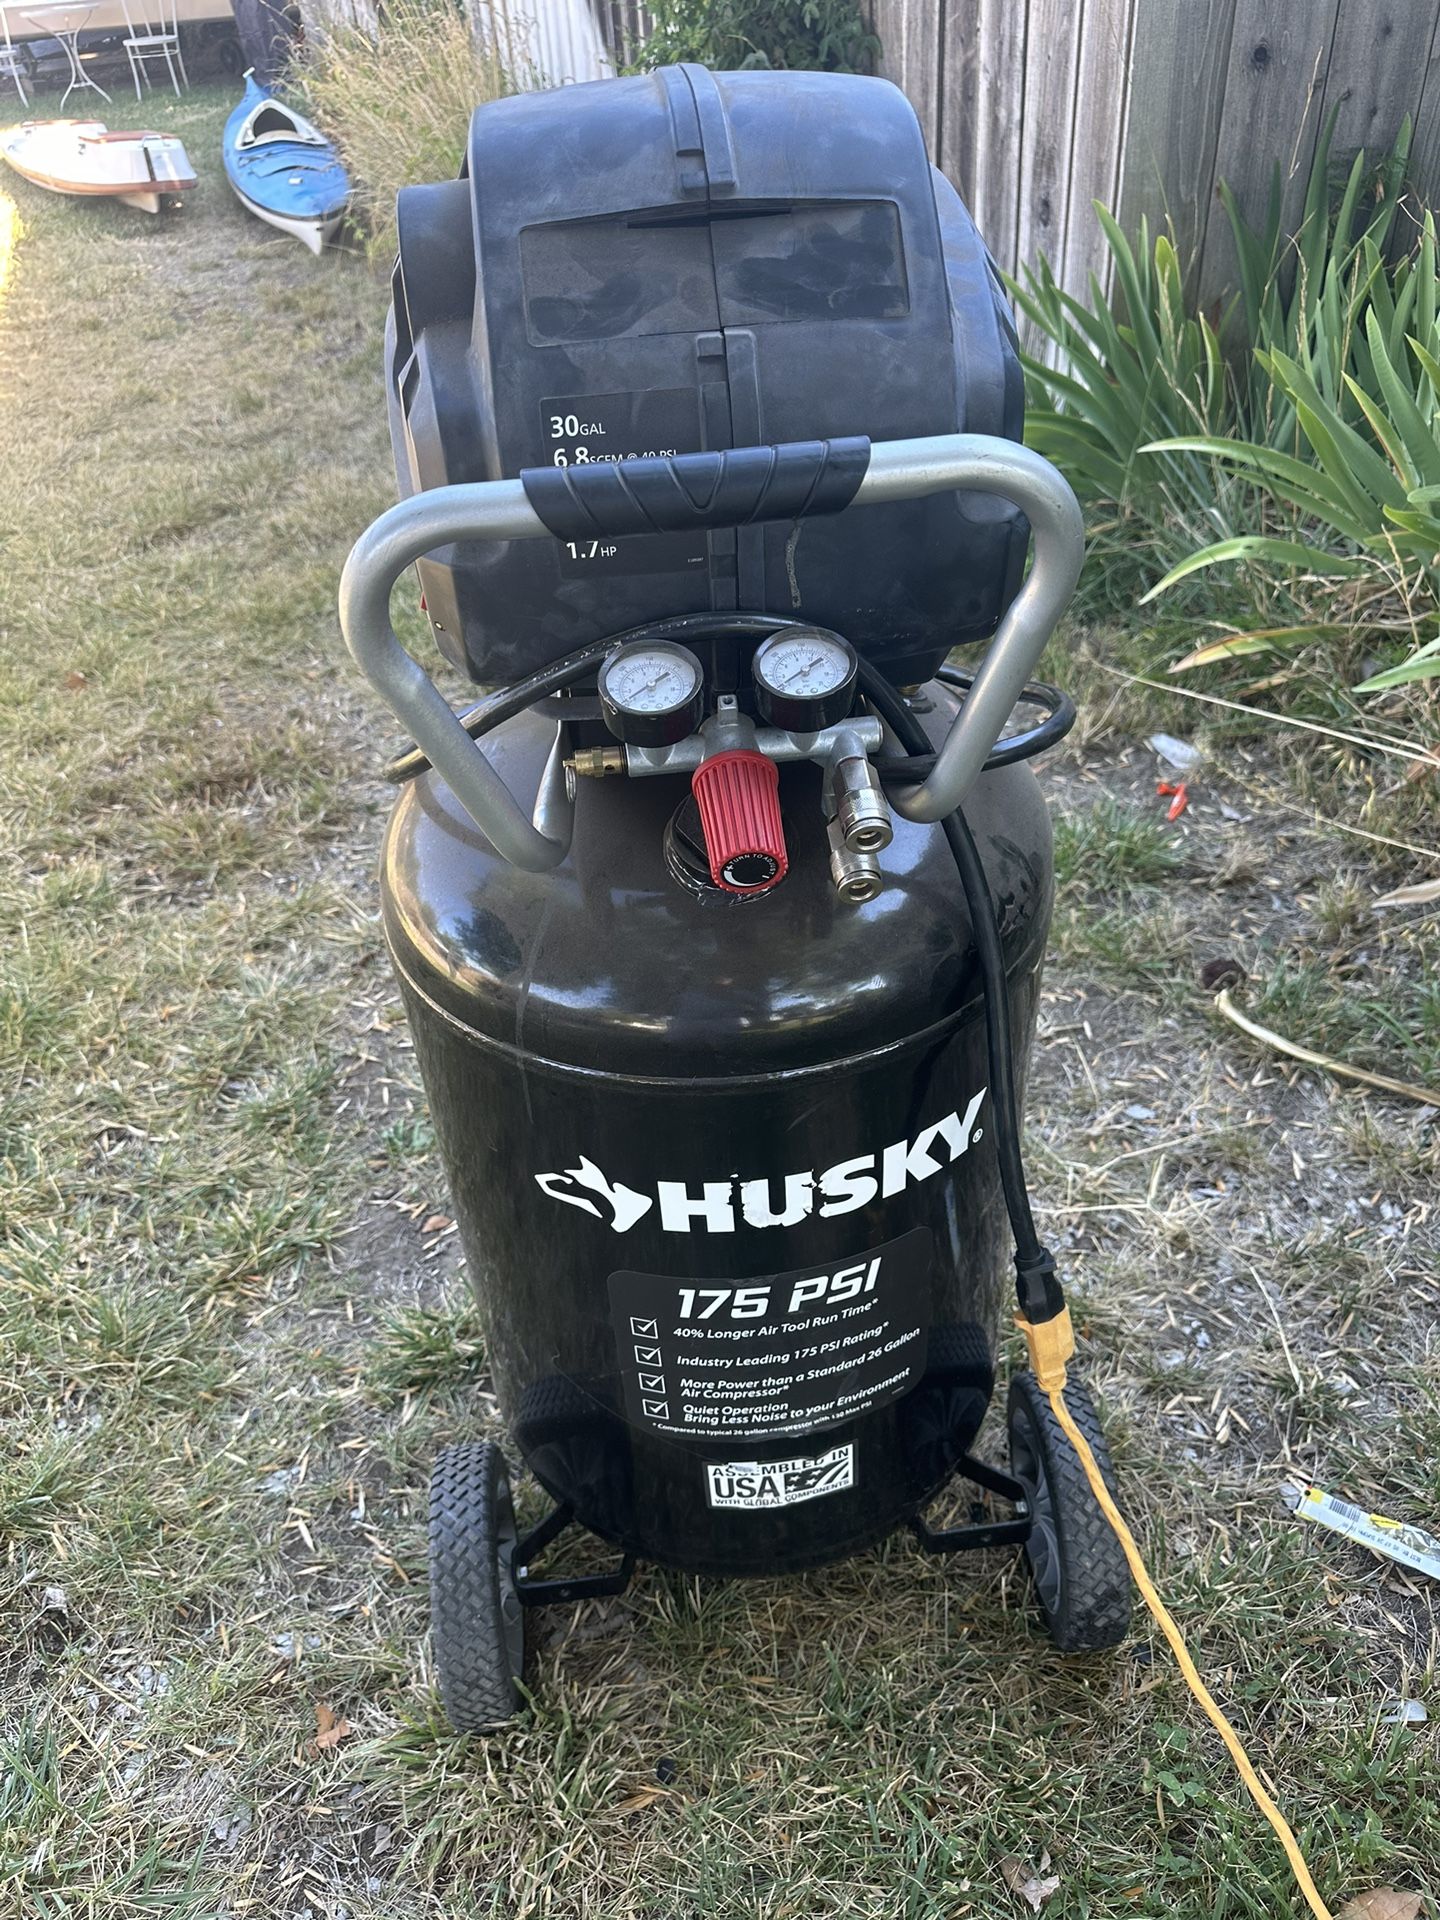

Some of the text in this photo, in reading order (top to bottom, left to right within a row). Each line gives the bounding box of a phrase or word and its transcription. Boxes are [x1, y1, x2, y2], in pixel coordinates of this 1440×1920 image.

[729, 854, 750, 865] TURN
[678, 1256, 882, 1319] 175 PSI
[673, 1327, 704, 1338] 40%
[707, 1329, 756, 1340] Longer
[757, 1326, 779, 1337] Air
[781, 1319, 810, 1333] Tool
[812, 1314, 838, 1327] Run
[677, 1355, 733, 1368] Industry
[736, 1353, 790, 1366] Leading
[794, 1346, 818, 1360] 175
[820, 1337, 841, 1354] PSI
[680, 1327, 920, 1390] More Power than a Standard 26 Gallon
[681, 1388, 701, 1398] Air
[684, 1413, 719, 1426] Bring
[722, 1414, 749, 1424] Less
[751, 1412, 788, 1423] Noise
[790, 1408, 804, 1419] to
[805, 1401, 836, 1417] your
[836, 1367, 911, 1407] Environment
[683, 1402, 788, 1416] Quiet Operation
[744, 1428, 768, 1436] gallon
[769, 1421, 812, 1432] compressor
[813, 1415, 830, 1424] with
[860, 1400, 872, 1409] PSI
[832, 1447, 849, 1461] IN
[714, 1476, 780, 1498] USA
[743, 1498, 782, 1506] GLOBAL
[784, 1479, 849, 1502] COMPONENTS
